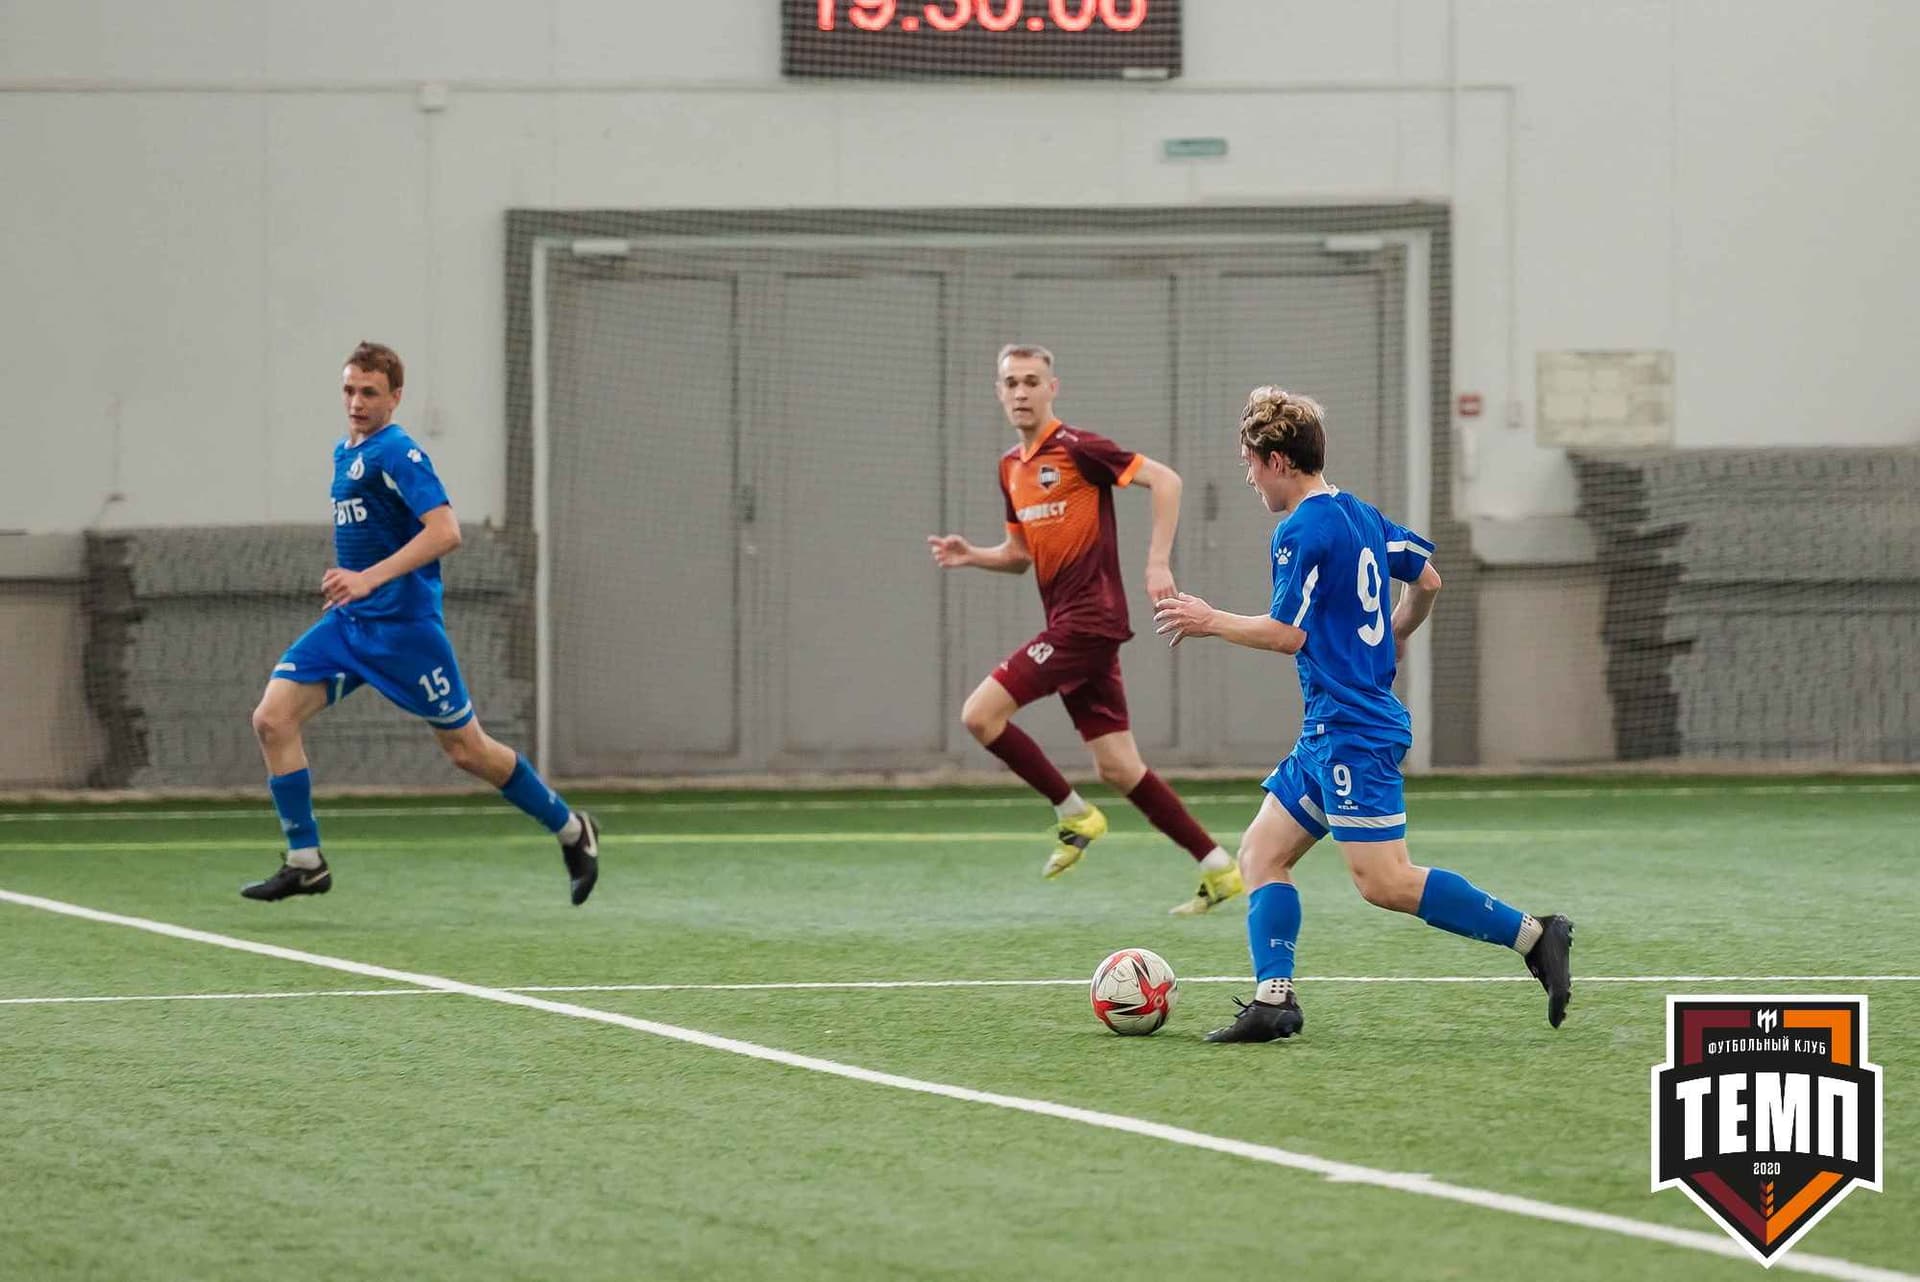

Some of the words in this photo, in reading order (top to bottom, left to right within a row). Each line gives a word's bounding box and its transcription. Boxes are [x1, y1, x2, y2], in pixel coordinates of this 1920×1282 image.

[1357, 547, 1385, 647] 9
[418, 666, 451, 702] 15
[1333, 764, 1352, 797] 9
